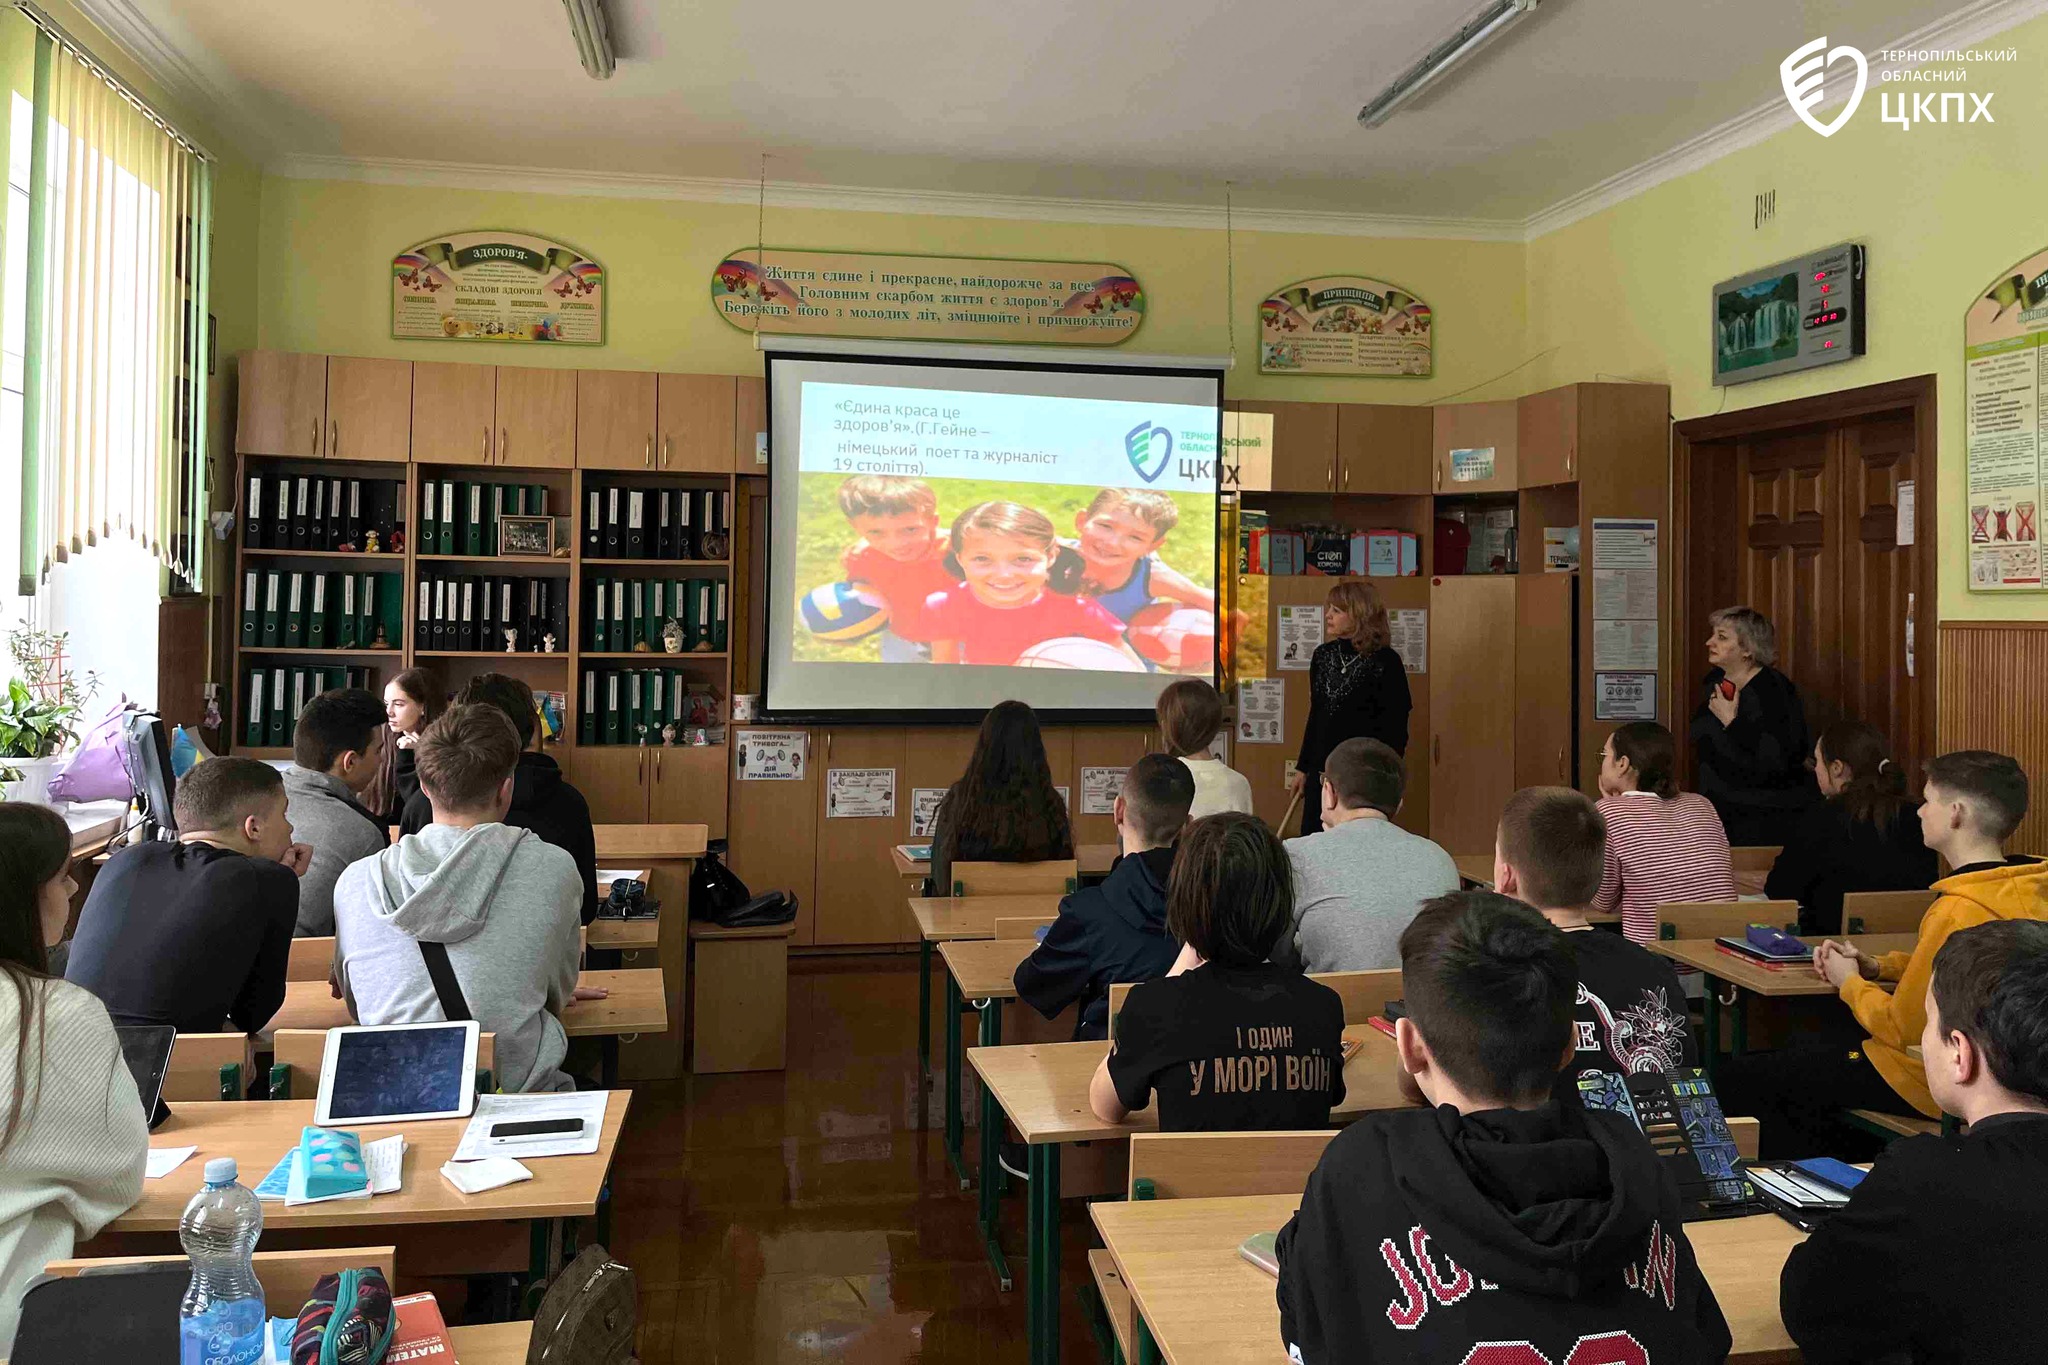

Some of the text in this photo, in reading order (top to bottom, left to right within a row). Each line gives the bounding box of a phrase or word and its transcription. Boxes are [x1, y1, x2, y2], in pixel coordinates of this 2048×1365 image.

[455, 285, 499, 294] СКЛАДОВІ
[766, 266, 815, 281] Життя
[822, 271, 863, 284] єдине
[869, 270, 875, 283] і
[882, 273, 957, 287] прекрасне,
[961, 275, 1043, 290] найдорожче
[1049, 281, 1063, 290] за
[800, 285, 869, 300] Головним
[877, 290, 934, 304] скарбом
[941, 295, 983, 305] життя
[990, 296, 997, 305] є
[724, 300, 1134, 328] Бережіть його з молодих літ, зміцнюйте і примножуйте!
[835, 399, 961, 421] «Єдина краса це
[837, 441, 1059, 465] німецький поет та журналіст
[833, 457, 929, 476] 19 століття).
[1236, 1026, 1293, 1051] І ОДИН
[1189, 1048, 1331, 1096] У МОРІ ВОЇН
